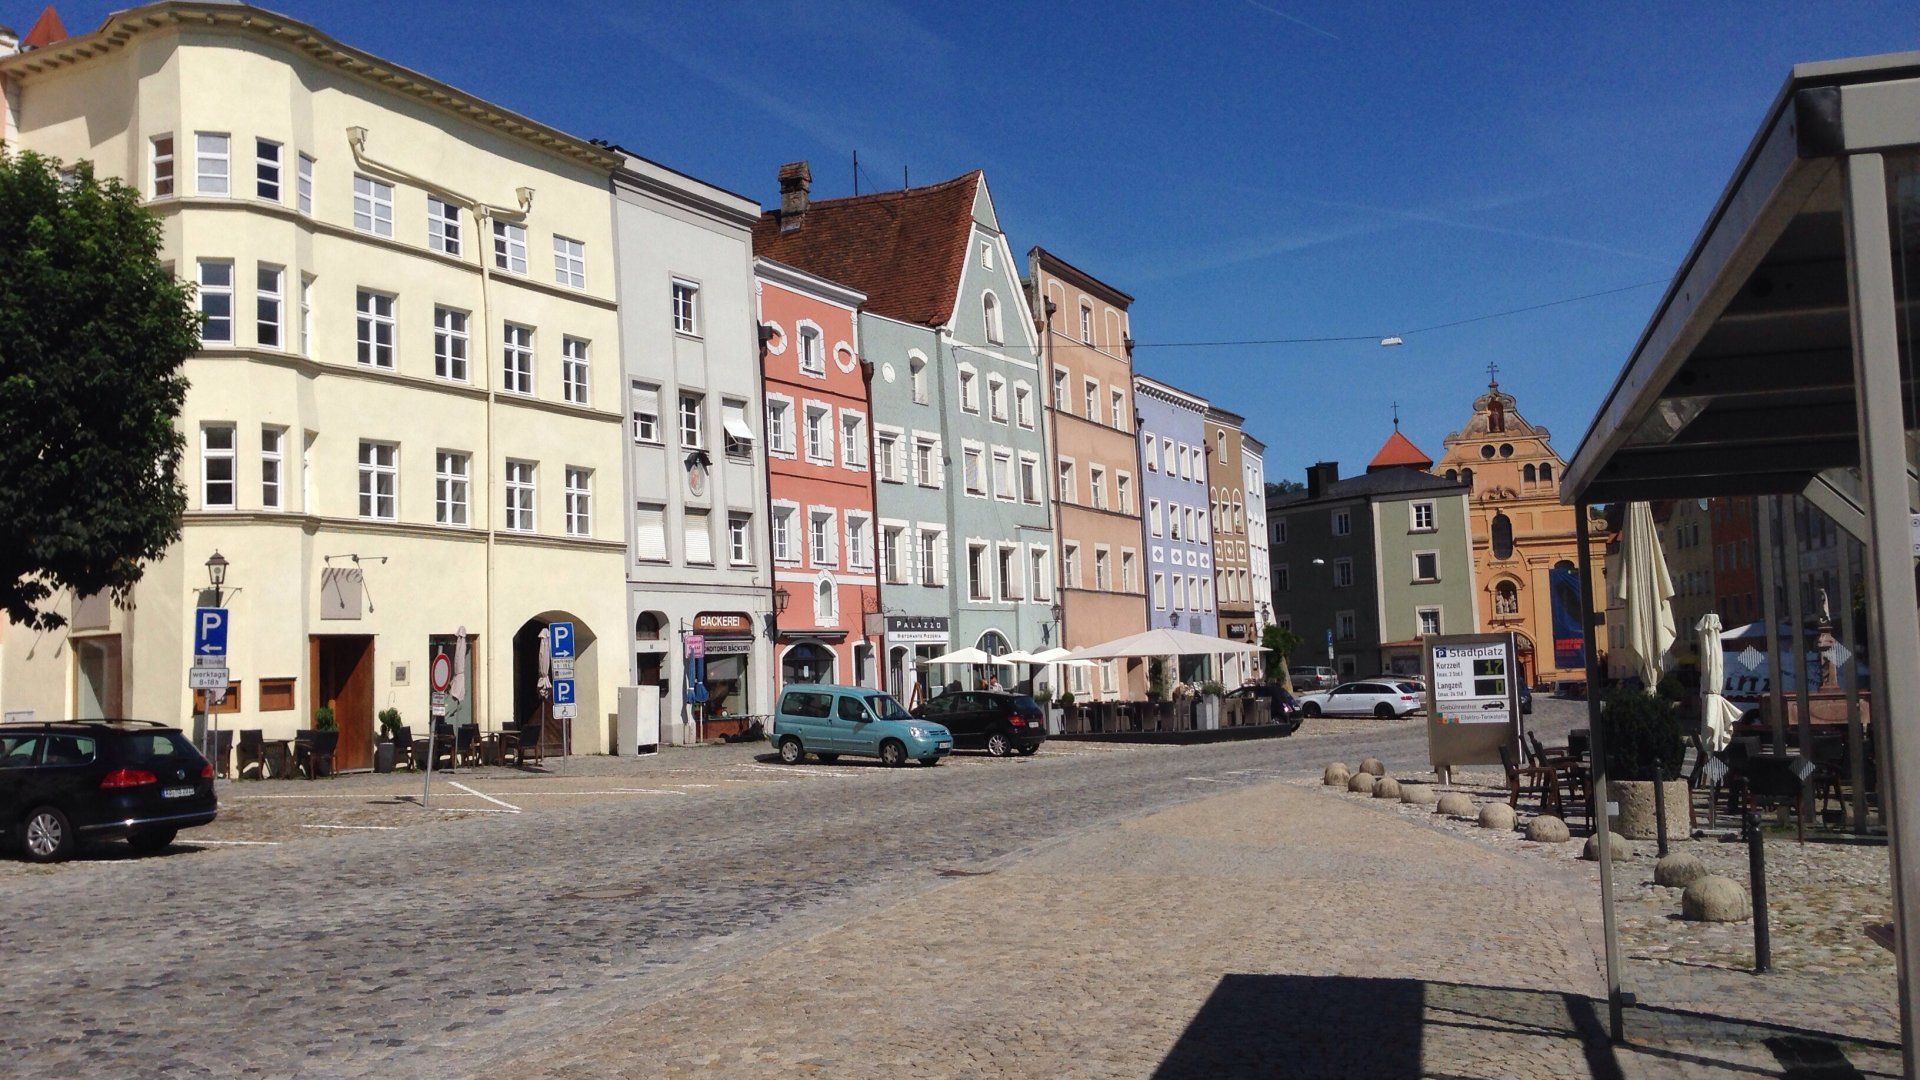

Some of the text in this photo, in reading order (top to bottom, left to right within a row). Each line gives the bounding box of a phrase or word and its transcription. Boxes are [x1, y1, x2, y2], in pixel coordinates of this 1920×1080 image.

[202, 613, 221, 640] P
[896, 620, 941, 629] PALAZZO
[554, 626, 569, 649] P
[1449, 647, 1503, 658] Stadtplatz
[1485, 660, 1503, 675] 17
[192, 671, 227, 680] werktags
[557, 682, 570, 702] P
[1437, 681, 1463, 690] Langzeit
